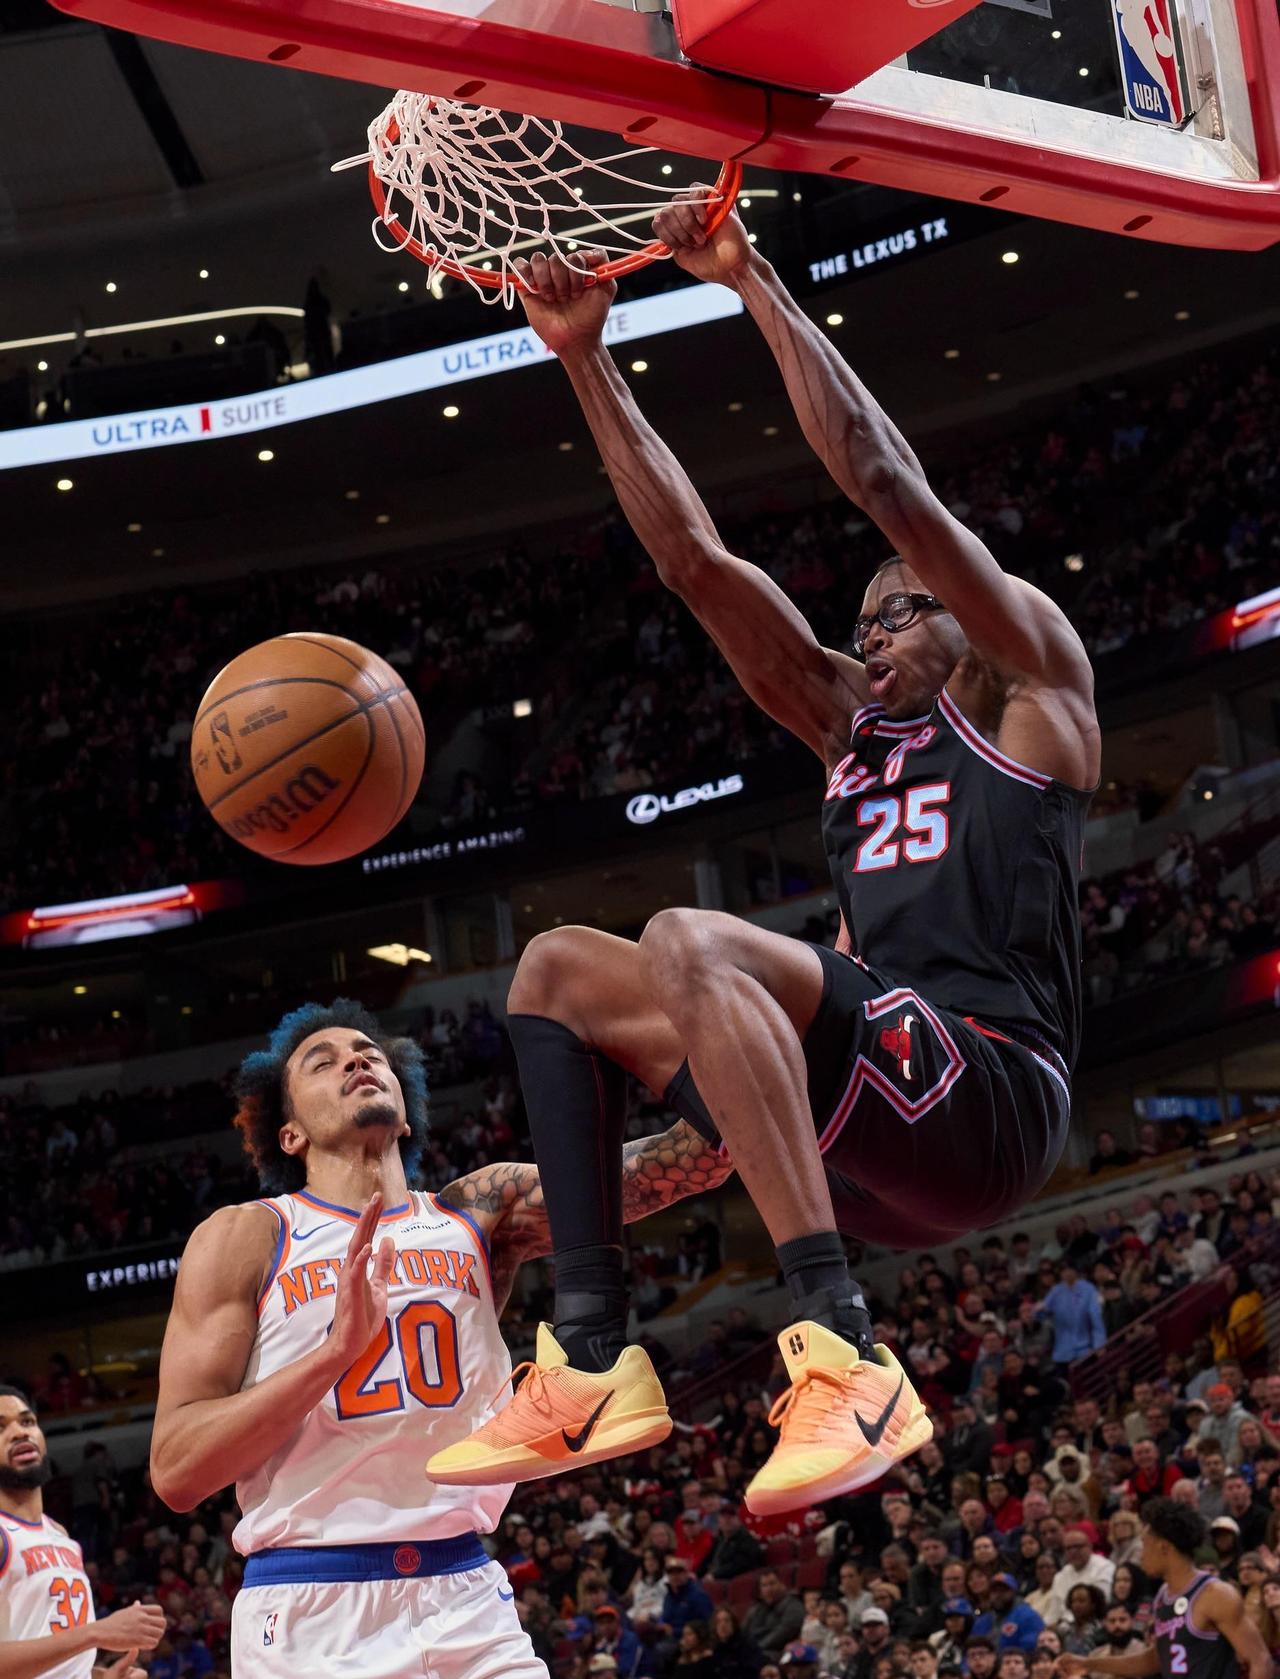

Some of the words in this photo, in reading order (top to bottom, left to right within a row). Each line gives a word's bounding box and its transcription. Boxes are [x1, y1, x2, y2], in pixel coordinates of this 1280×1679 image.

[1132, 81, 1164, 114] NBA
[809, 253, 848, 283] THE
[852, 229, 917, 268] LEXUS
[920, 217, 948, 243] TX
[443, 337, 535, 375] ULTRA
[92, 415, 190, 446] ULTRA
[222, 396, 288, 428] SUITE
[660, 774, 744, 812] LEXUS
[852, 781, 951, 873] 25
[362, 842, 452, 874] EXPERIENCE
[86, 1256, 182, 1292] EXPERIEN
[327, 1300, 465, 1422] 20
[48, 1577, 89, 1635] 32
[1169, 1643, 1188, 1674] 2
